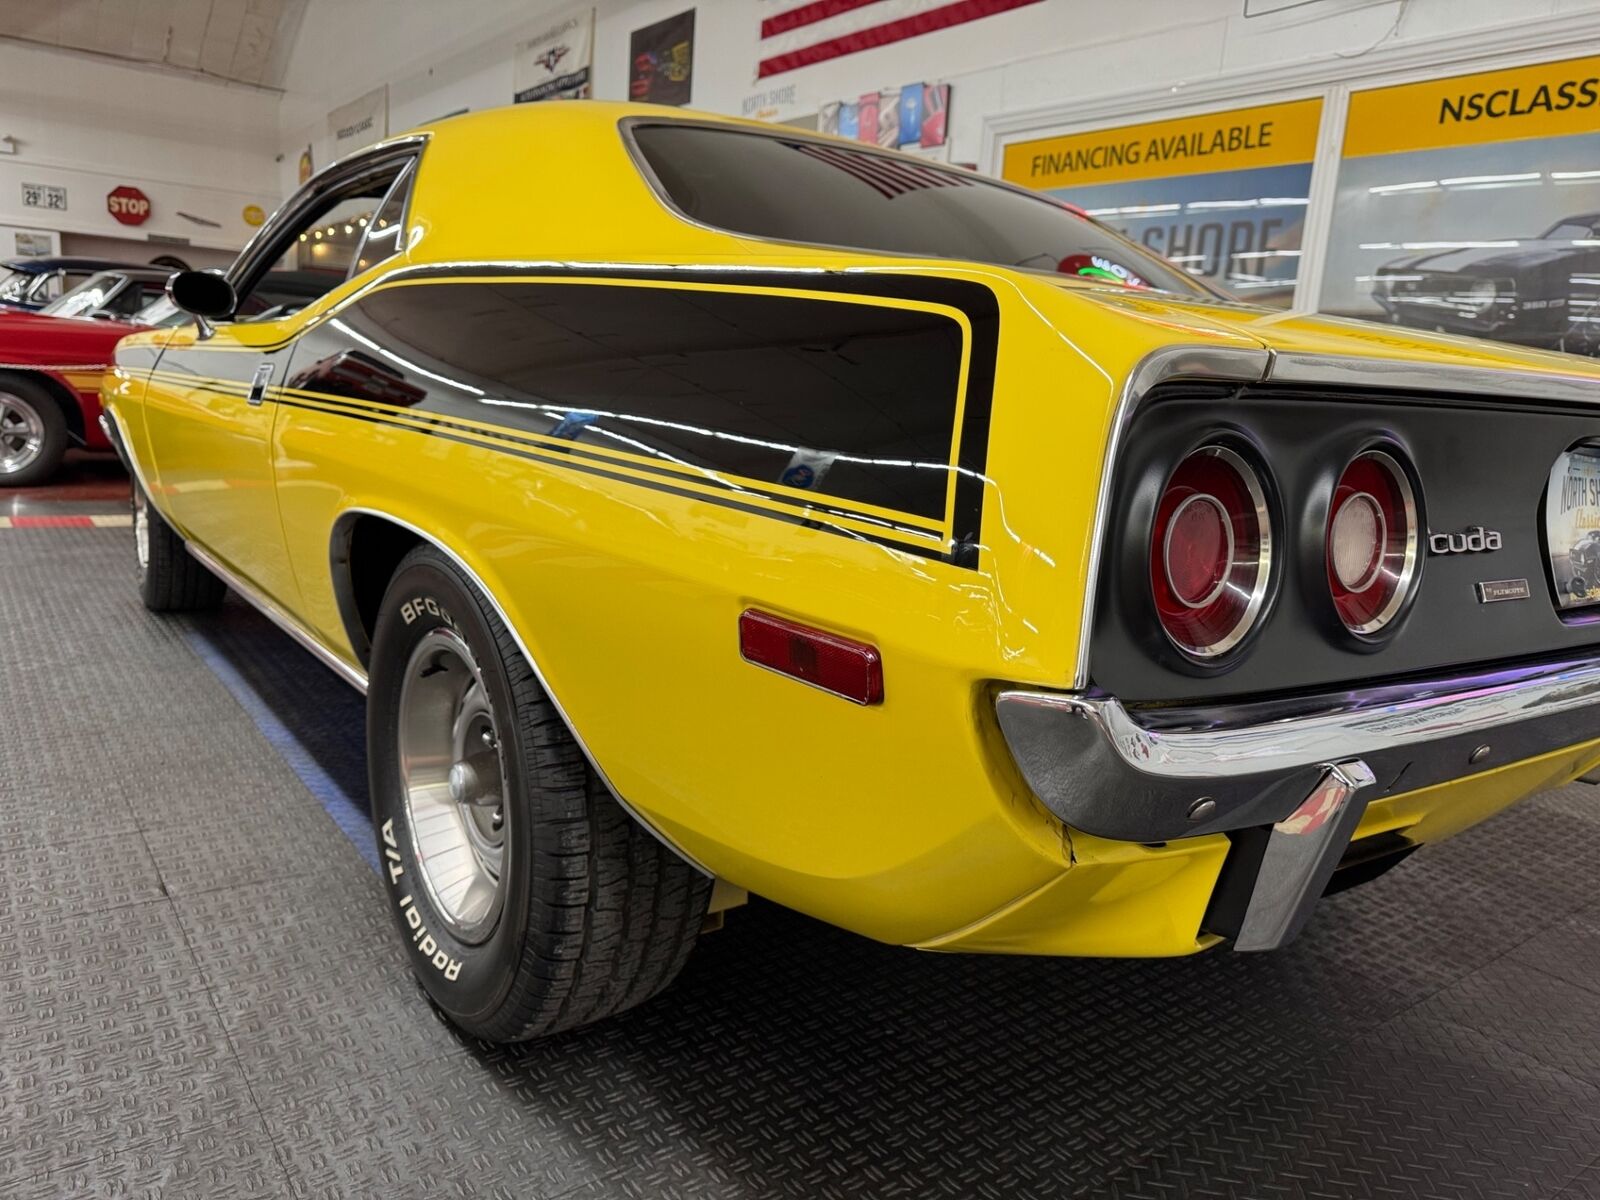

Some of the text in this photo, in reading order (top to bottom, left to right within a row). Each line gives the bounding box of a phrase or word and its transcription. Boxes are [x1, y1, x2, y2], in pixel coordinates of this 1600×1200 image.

[1031, 121, 1273, 177] FINANCING AVAILABLE
[109, 196, 148, 216] STOP
[1560, 475, 1587, 515] NORTH
[381, 817, 463, 982] Radial T/A
